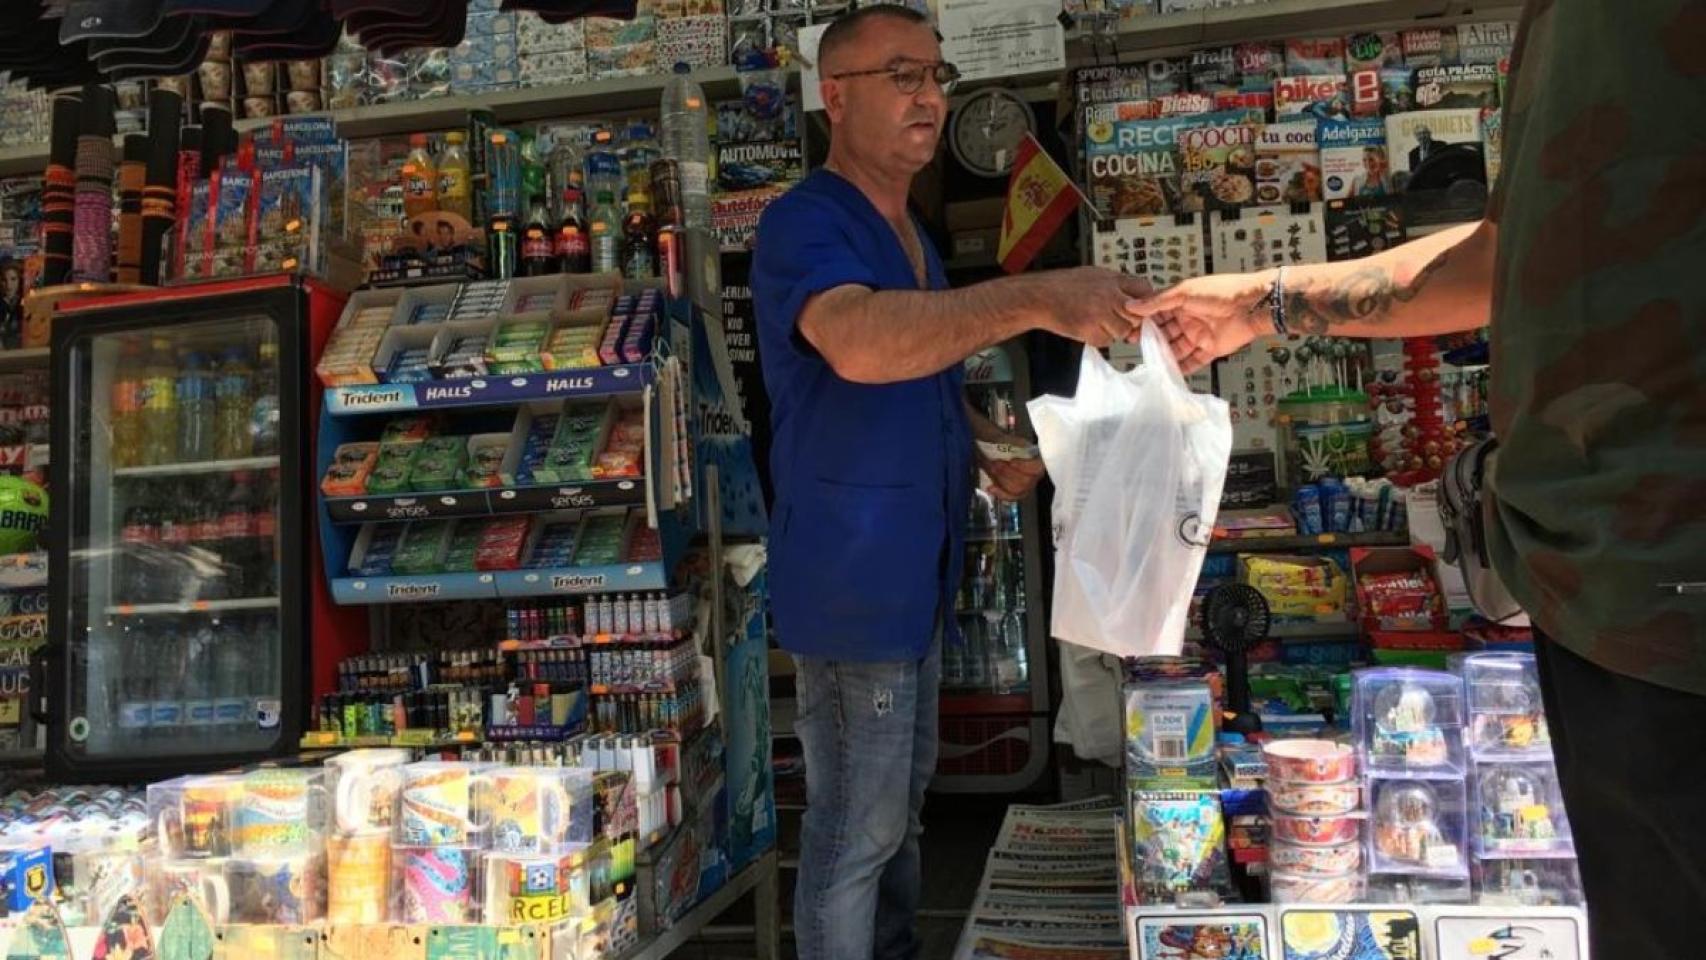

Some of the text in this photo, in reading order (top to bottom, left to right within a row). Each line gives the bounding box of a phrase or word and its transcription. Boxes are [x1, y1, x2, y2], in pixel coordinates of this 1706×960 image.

[1262, 129, 1279, 144] tu
[1091, 150, 1176, 178] COCINA
[546, 377, 594, 392] HALLS
[342, 390, 400, 406] Trident
[426, 386, 473, 401] HALLS
[552, 575, 604, 588] Trident
[388, 583, 440, 597] Trident
